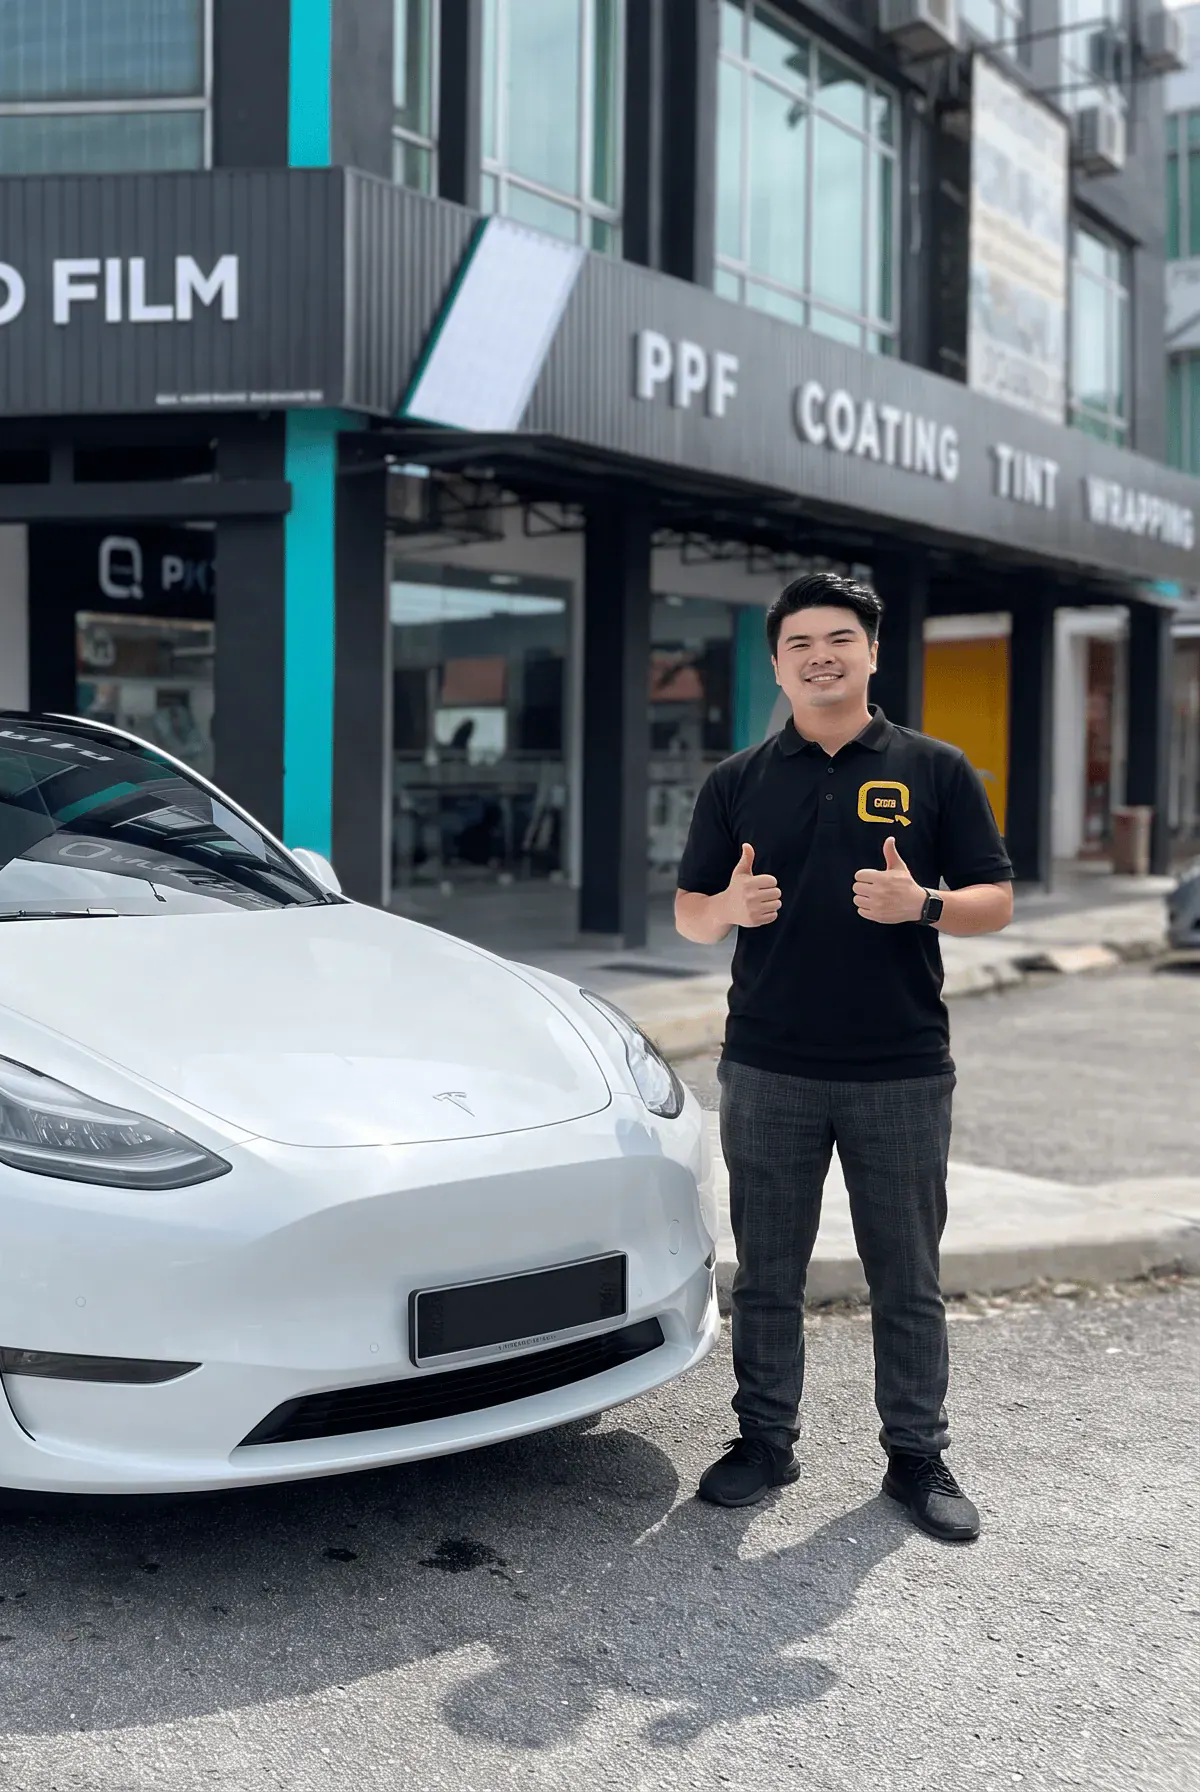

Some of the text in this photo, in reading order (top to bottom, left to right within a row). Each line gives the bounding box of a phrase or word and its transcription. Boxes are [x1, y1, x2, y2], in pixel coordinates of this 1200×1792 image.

[53, 255, 239, 324] FILM
[638, 329, 1194, 551] PPF COATING TINT WRAPPING
